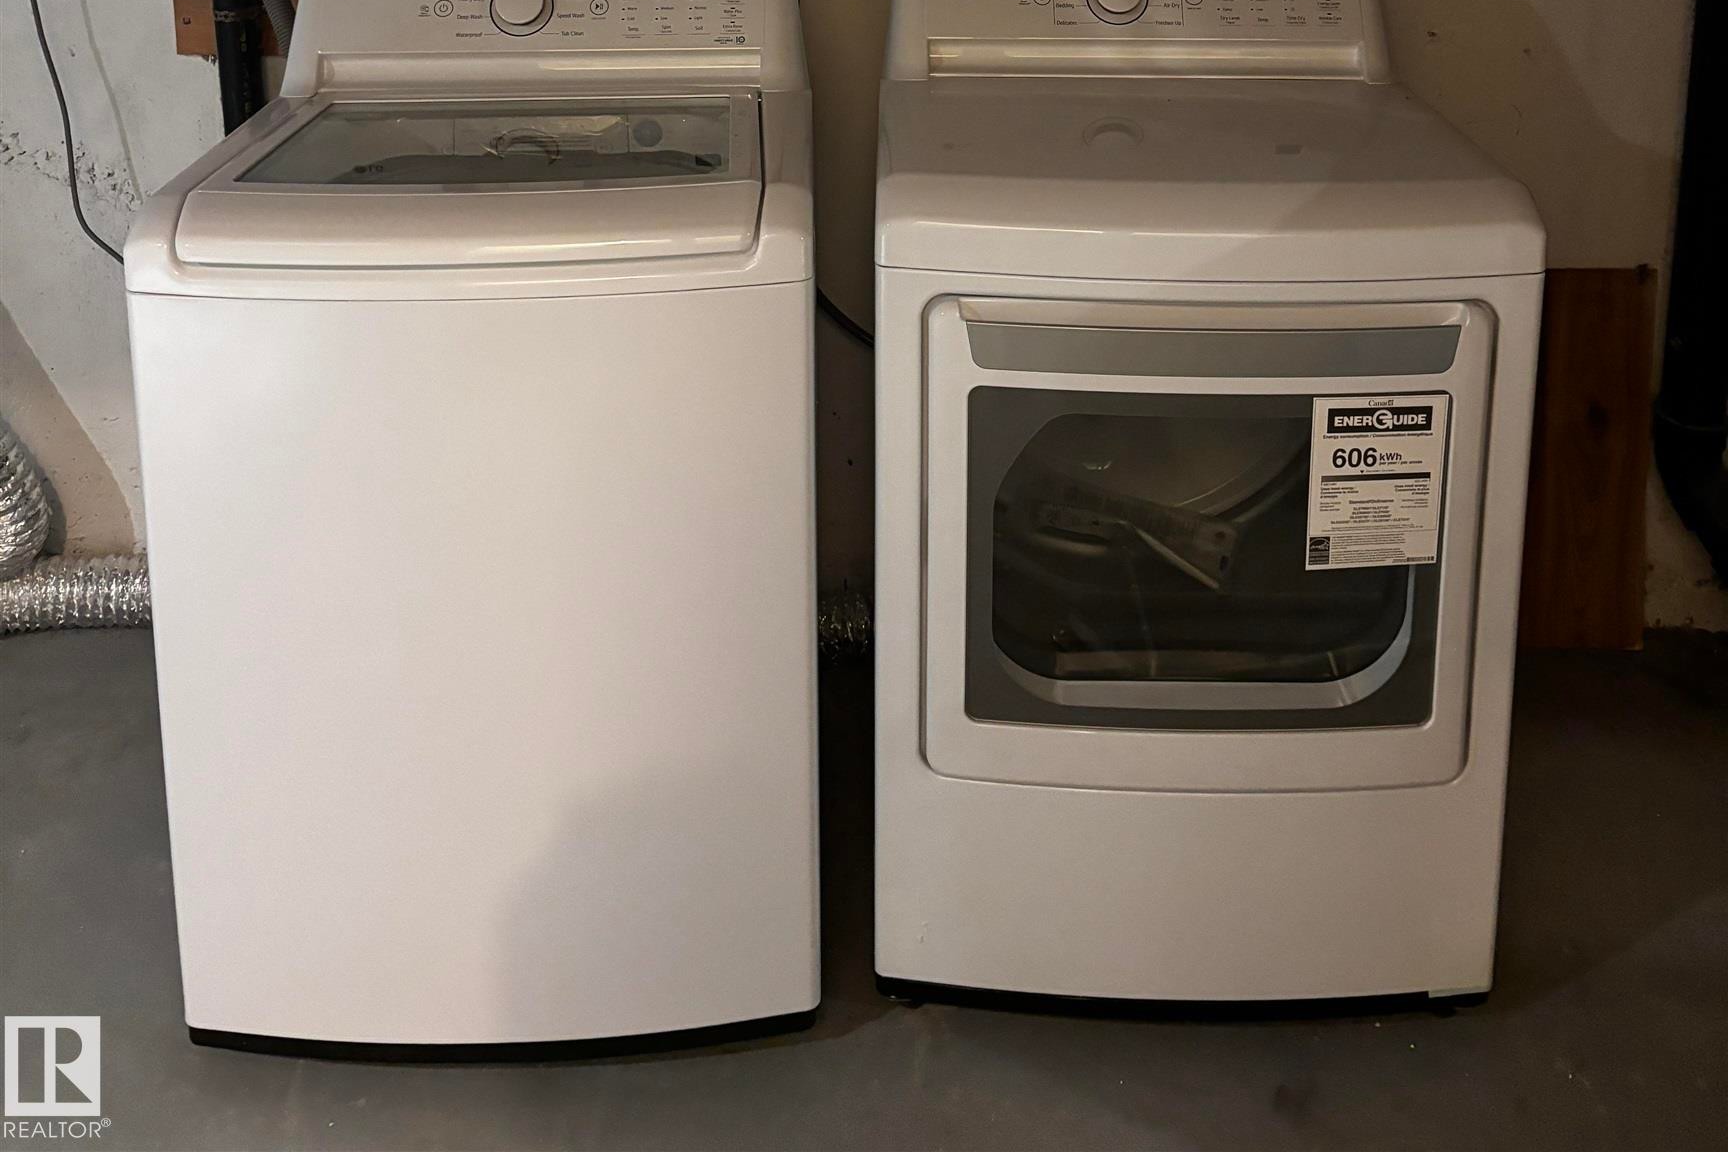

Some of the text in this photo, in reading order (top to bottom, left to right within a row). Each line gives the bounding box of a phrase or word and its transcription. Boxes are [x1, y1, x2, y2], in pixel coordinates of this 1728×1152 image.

[1333, 409, 1427, 430] ENERGUIDE
[1332, 447, 1378, 468] 606
[1379, 452, 1402, 461] kWh
